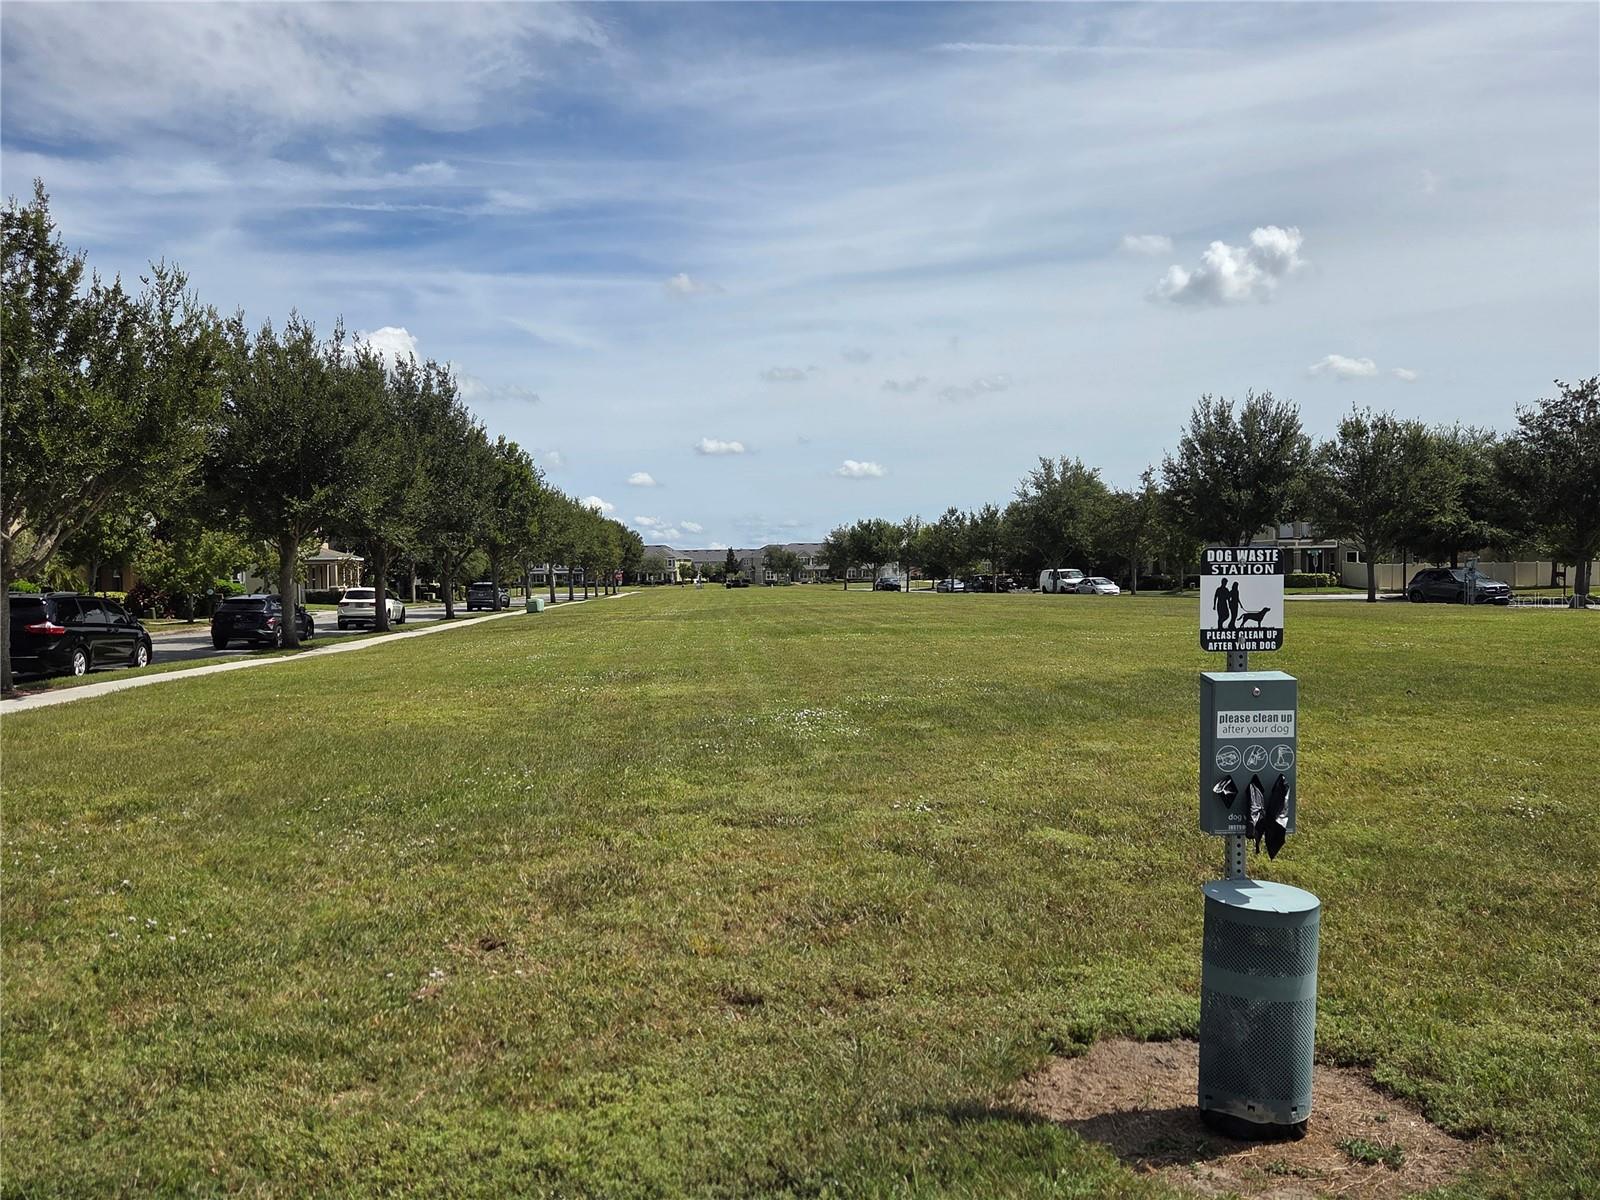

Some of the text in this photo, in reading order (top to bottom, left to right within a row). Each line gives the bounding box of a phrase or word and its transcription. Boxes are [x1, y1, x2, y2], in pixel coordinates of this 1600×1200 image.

[1207, 549, 1279, 562] DOG WASTE
[1211, 564, 1274, 575] STATION
[1206, 630, 1278, 640] PLEASE CLEAN UP
[1208, 641, 1277, 651] AFTER YOUR DOG
[1219, 713, 1293, 724] please clean up
[1222, 724, 1290, 735] after your dog
[1228, 813, 1242, 823] dog
